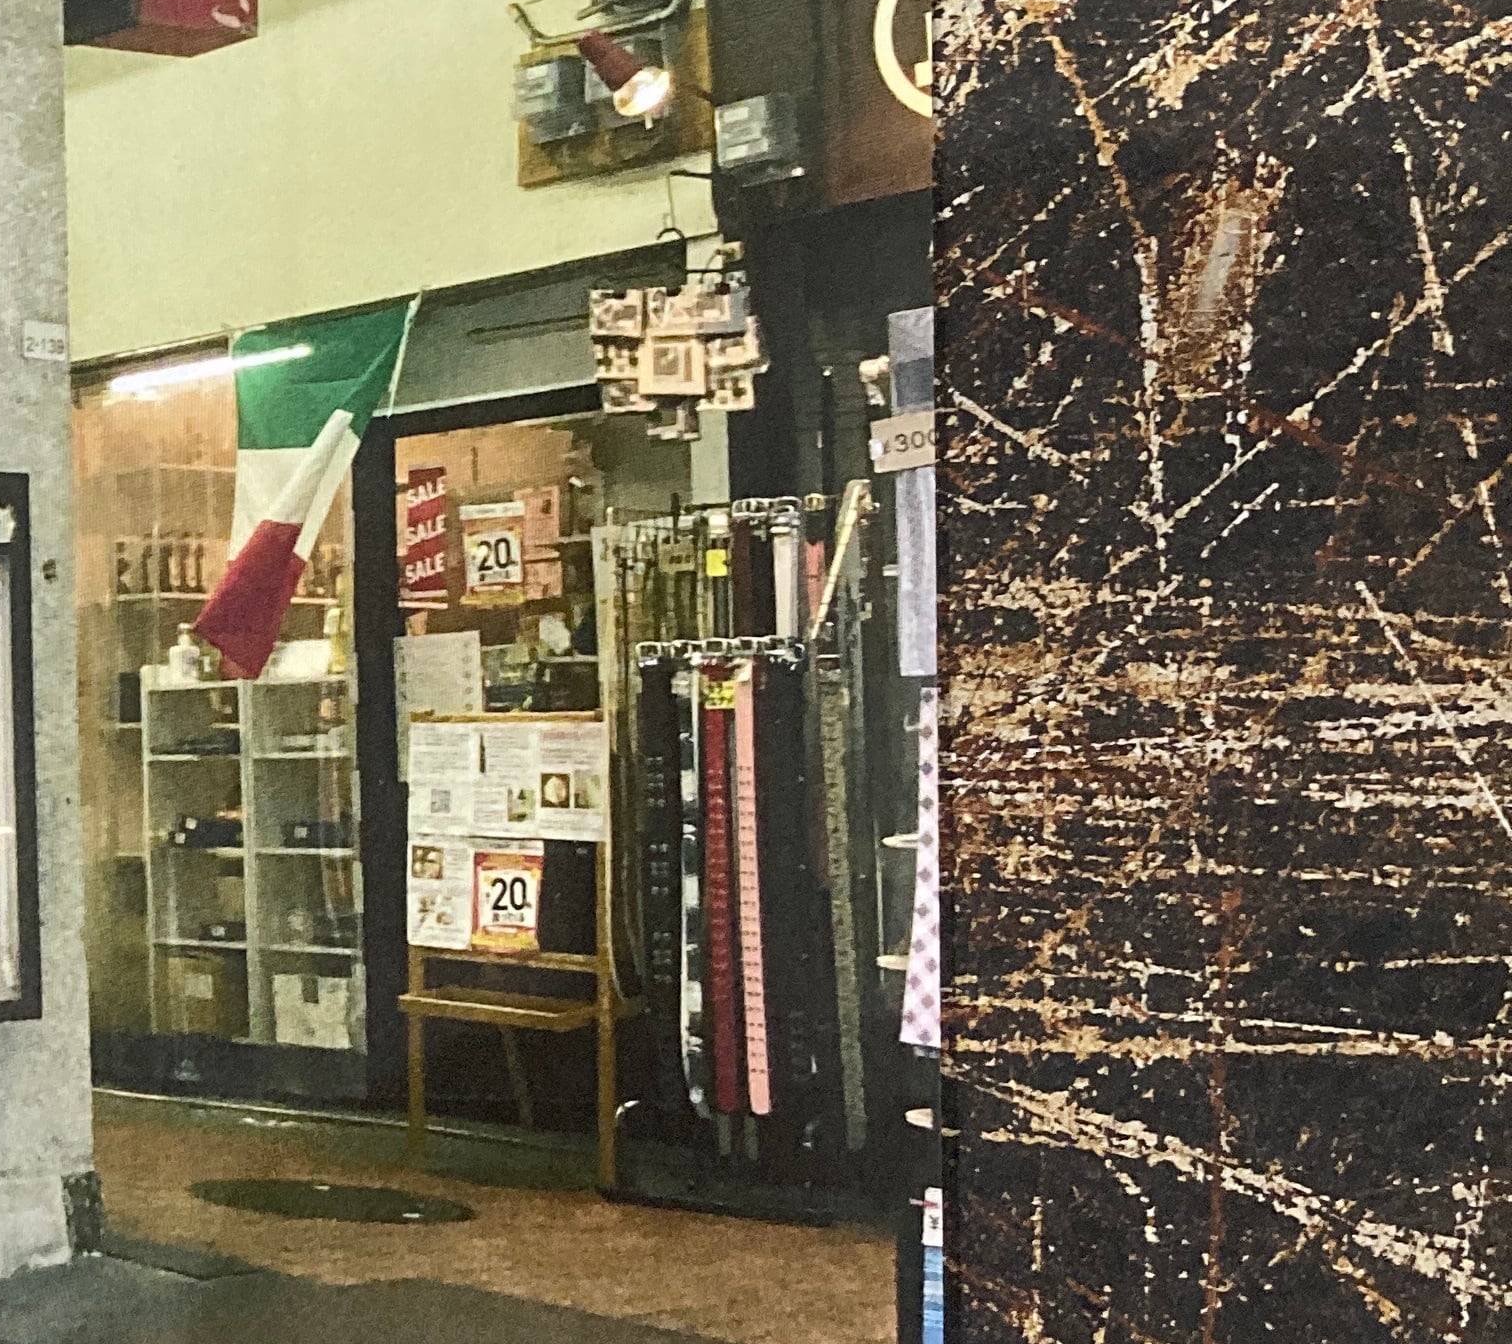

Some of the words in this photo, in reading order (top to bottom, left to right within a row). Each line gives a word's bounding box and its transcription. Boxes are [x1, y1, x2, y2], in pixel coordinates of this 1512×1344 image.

[406, 477, 446, 506] SALE
[406, 514, 446, 545] SALE
[405, 552, 445, 584] SALE
[478, 537, 511, 572] 20
[491, 876, 528, 911] 20
